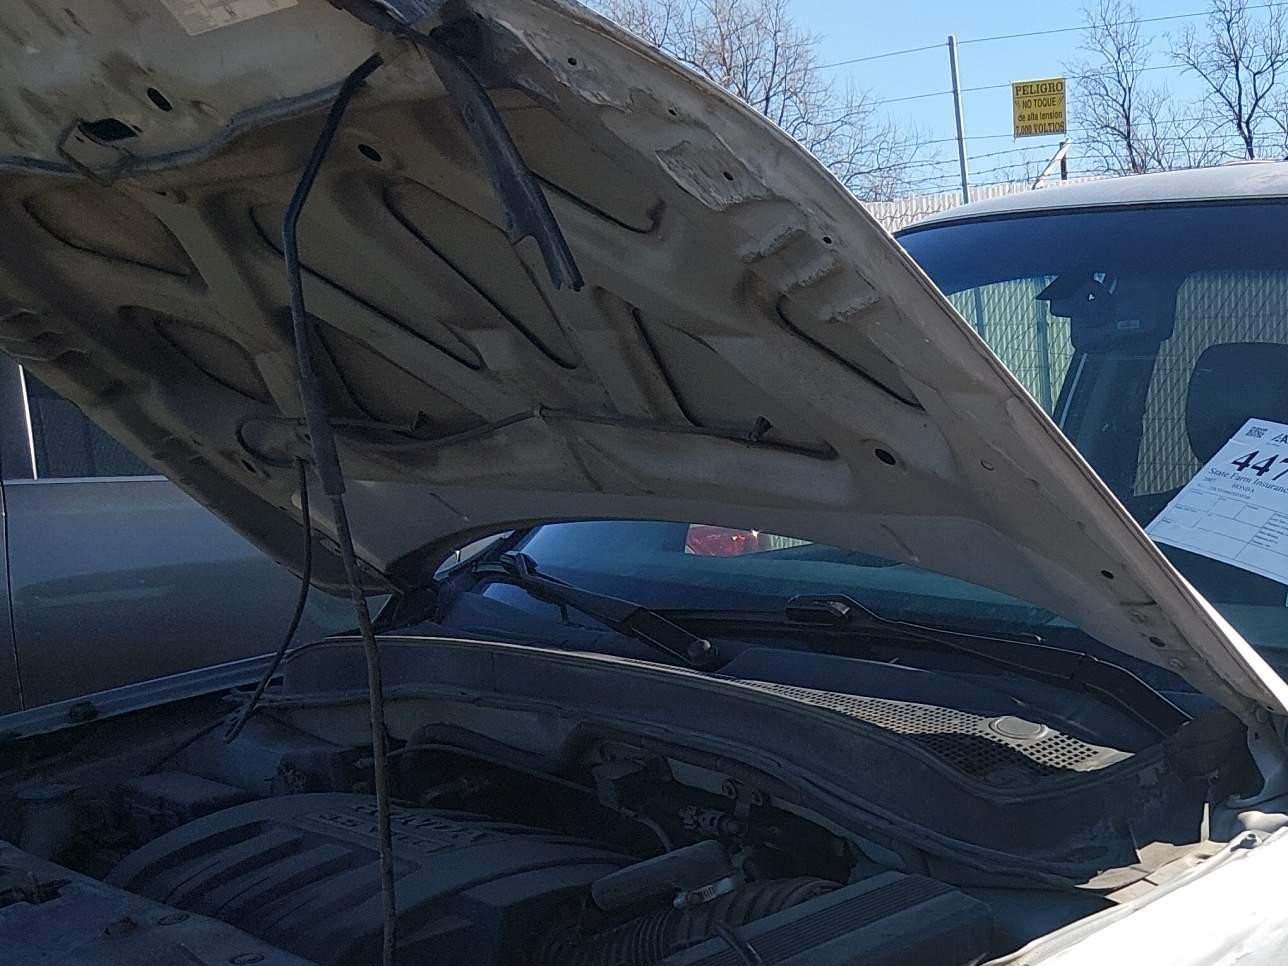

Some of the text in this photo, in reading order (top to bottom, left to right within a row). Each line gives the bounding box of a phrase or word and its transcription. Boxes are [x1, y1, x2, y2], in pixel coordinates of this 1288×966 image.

[1015, 81, 1064, 96] PELIGRO
[1022, 97, 1057, 109] NO TOQUE
[1018, 114, 1026, 122] de
[1028, 112, 1039, 121] alta
[1034, 121, 1065, 134] VOLTIOS
[1208, 467, 1230, 478] State
[1230, 472, 1252, 485] Farm
